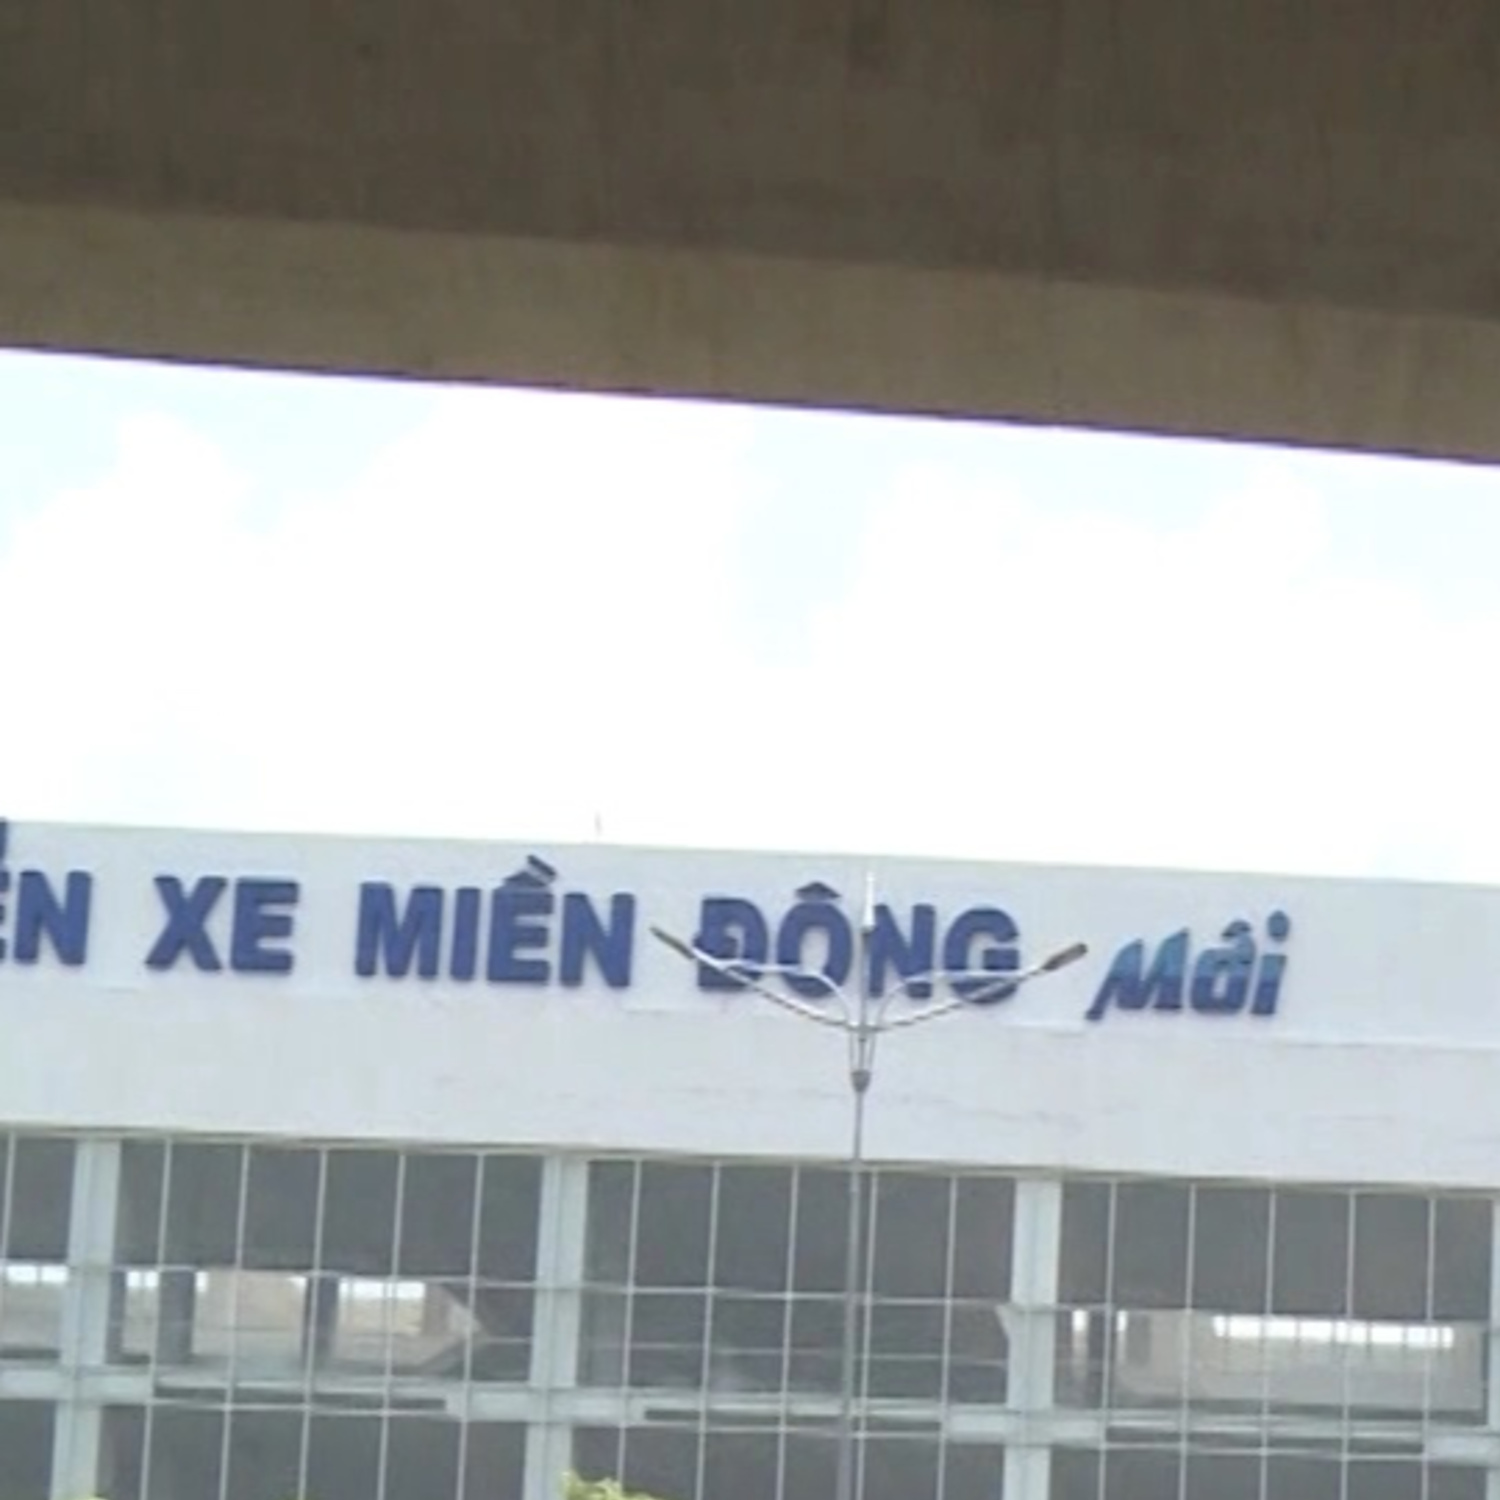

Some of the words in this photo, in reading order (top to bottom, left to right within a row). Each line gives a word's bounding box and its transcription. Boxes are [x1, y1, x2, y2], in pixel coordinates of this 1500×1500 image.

[145, 875, 301, 974] XE
[354, 855, 636, 989] MIỀN
[693, 881, 1021, 1004] ĐÔNG
